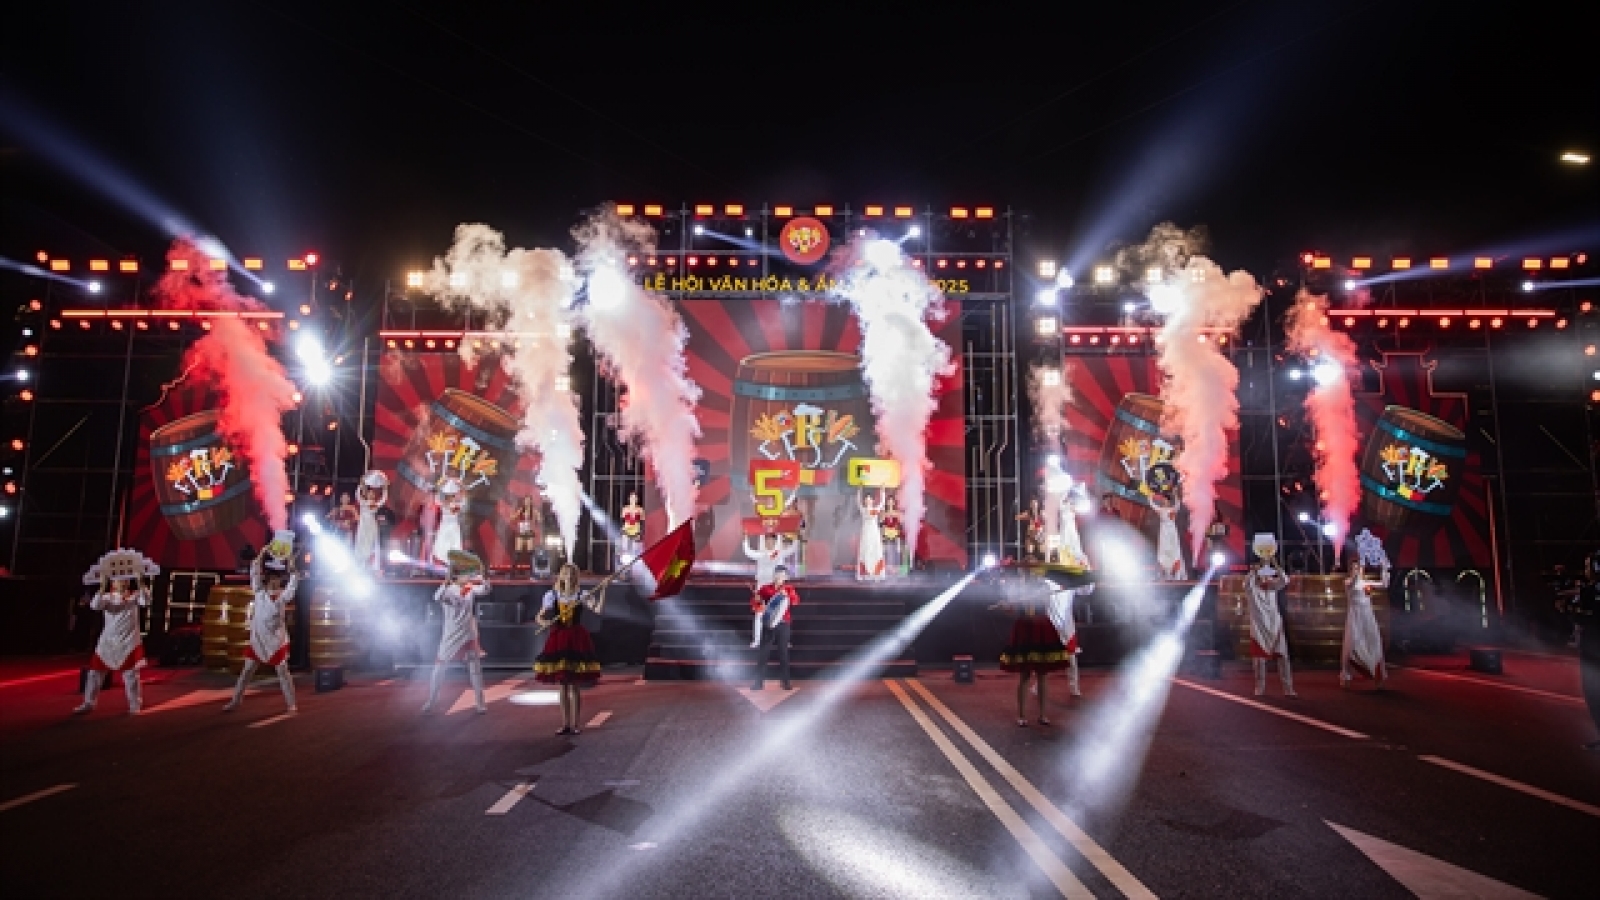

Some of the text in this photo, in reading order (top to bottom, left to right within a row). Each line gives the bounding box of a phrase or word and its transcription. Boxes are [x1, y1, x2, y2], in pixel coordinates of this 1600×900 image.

[672, 274, 703, 292] HỘI
[708, 274, 747, 291] VĂN
[798, 277, 810, 291] &
[754, 469, 783, 516] 5
